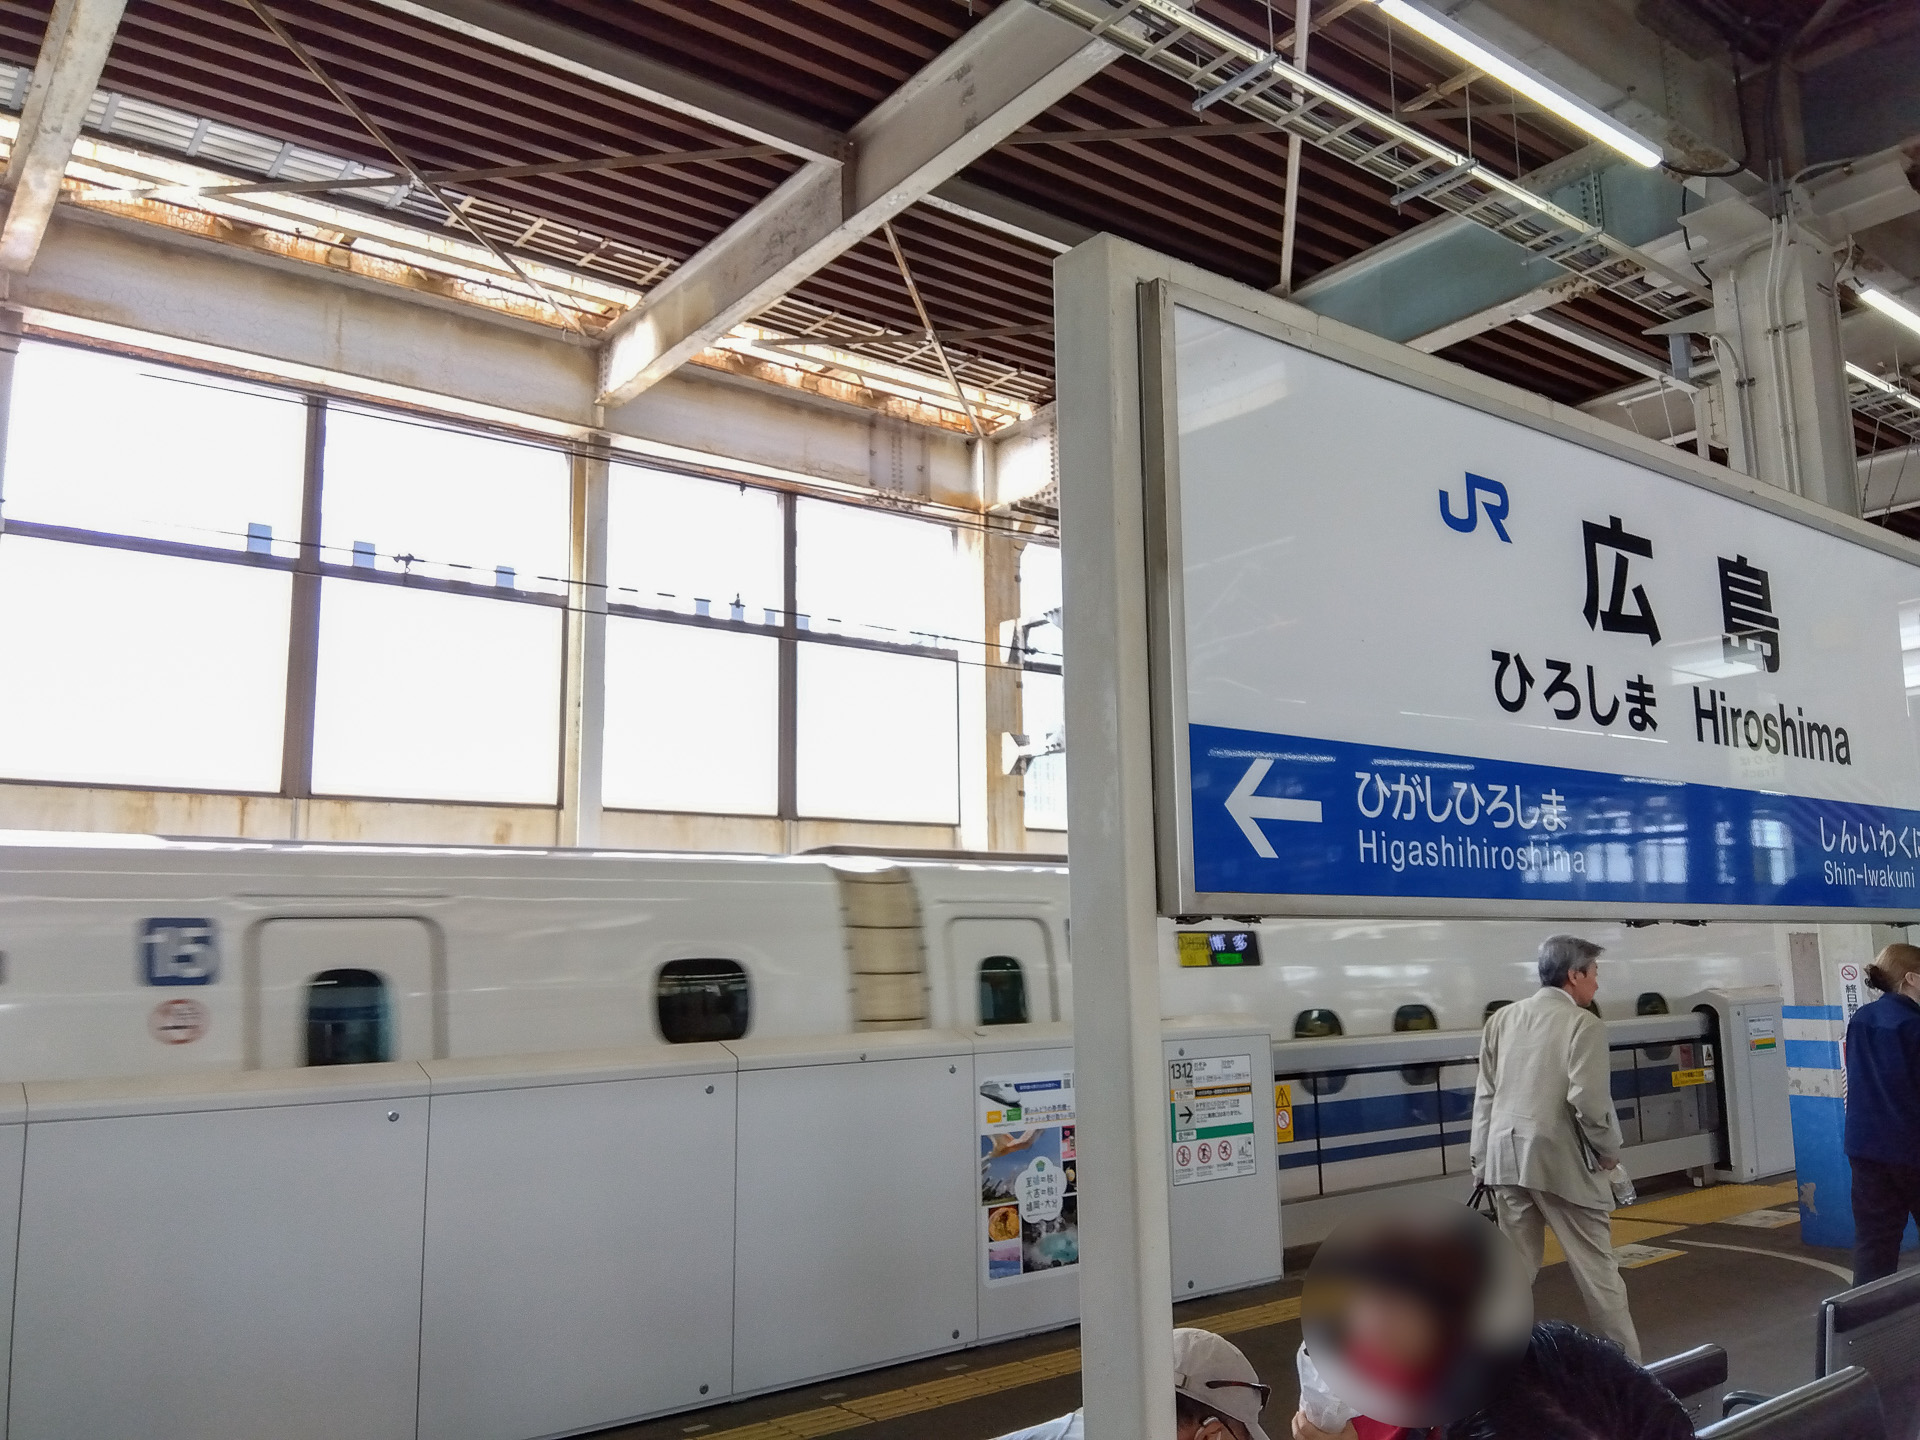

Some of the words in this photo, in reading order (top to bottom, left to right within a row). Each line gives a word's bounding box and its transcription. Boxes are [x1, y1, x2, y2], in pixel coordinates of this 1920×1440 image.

[1438, 471, 1513, 544] JR
[1582, 514, 1780, 673] 広島
[1491, 649, 1659, 732] ひろしま
[1693, 685, 1852, 766] Hiroshima
[1355, 771, 1567, 832] ひがしひろしま
[1358, 829, 1587, 873] Higashihiroshima
[1824, 860, 1916, 888] Shin-Iwakuni
